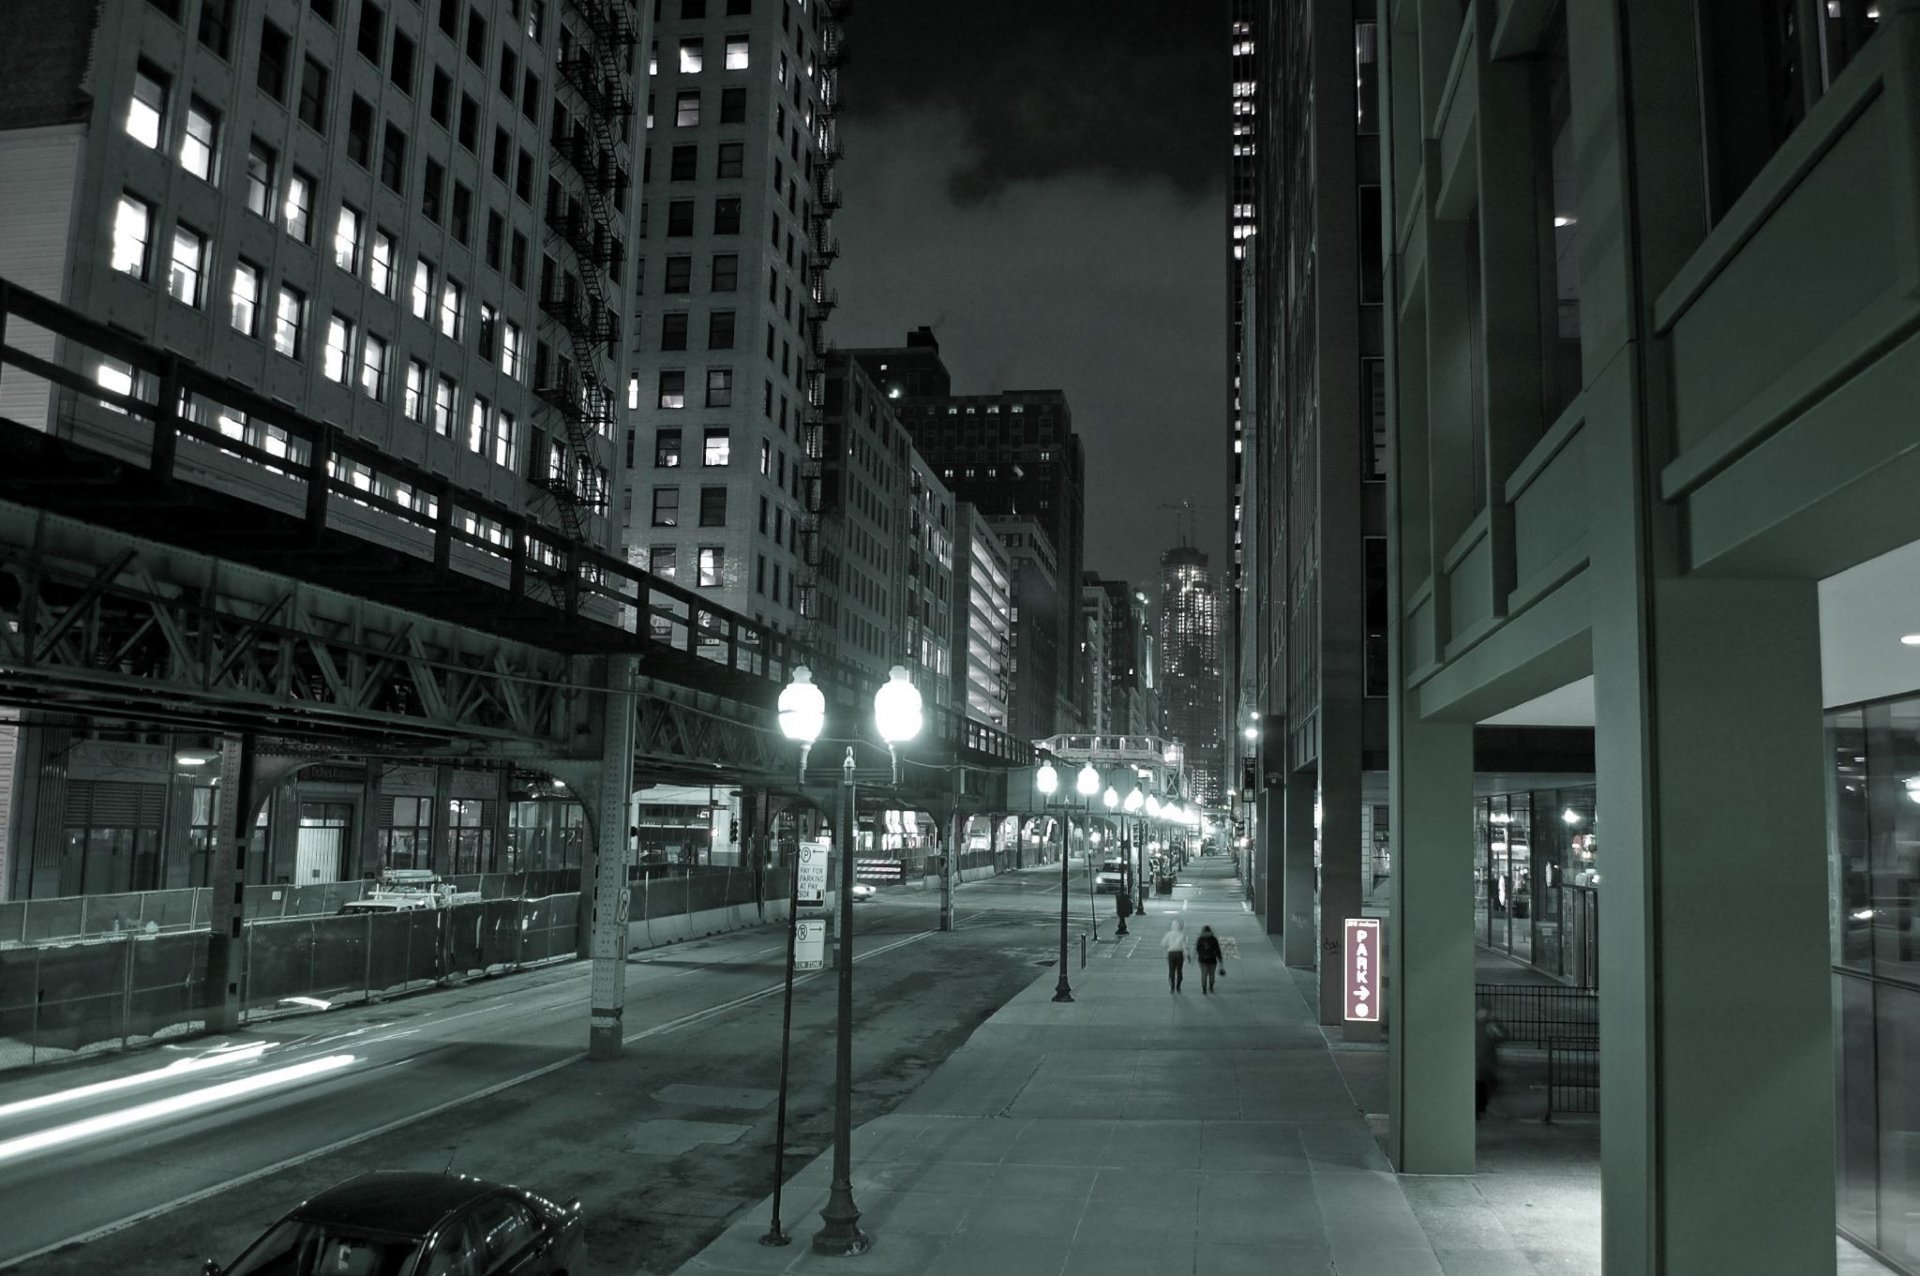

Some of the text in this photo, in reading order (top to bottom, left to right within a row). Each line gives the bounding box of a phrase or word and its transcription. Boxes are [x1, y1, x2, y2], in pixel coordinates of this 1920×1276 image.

[800, 867, 823, 875] PAY FOR
[799, 882, 818, 890] AT PAY
[798, 890, 810, 898] BOX
[1356, 929, 1368, 984] PARK
